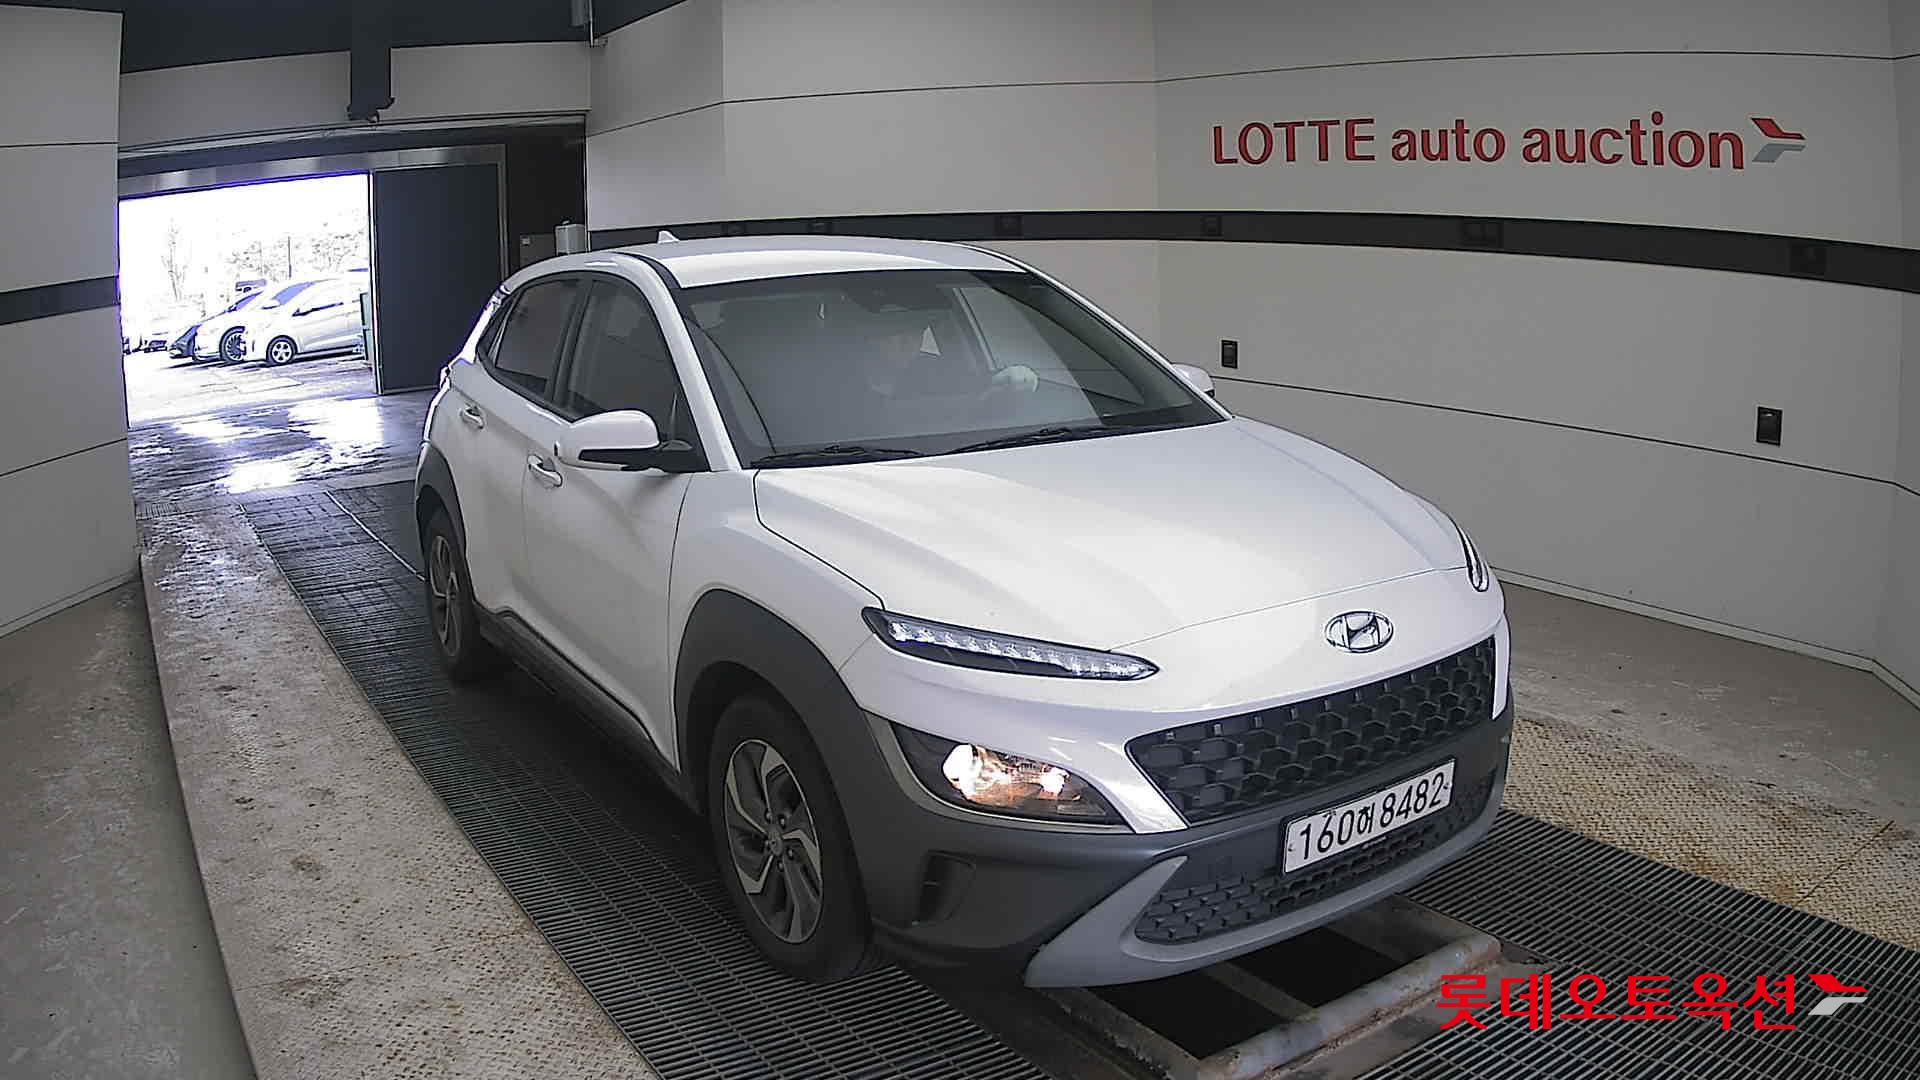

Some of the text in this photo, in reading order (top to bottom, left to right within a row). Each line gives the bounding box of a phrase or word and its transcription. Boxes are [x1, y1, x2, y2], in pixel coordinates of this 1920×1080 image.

[1212, 112, 1745, 170] LOTTE auto auction
